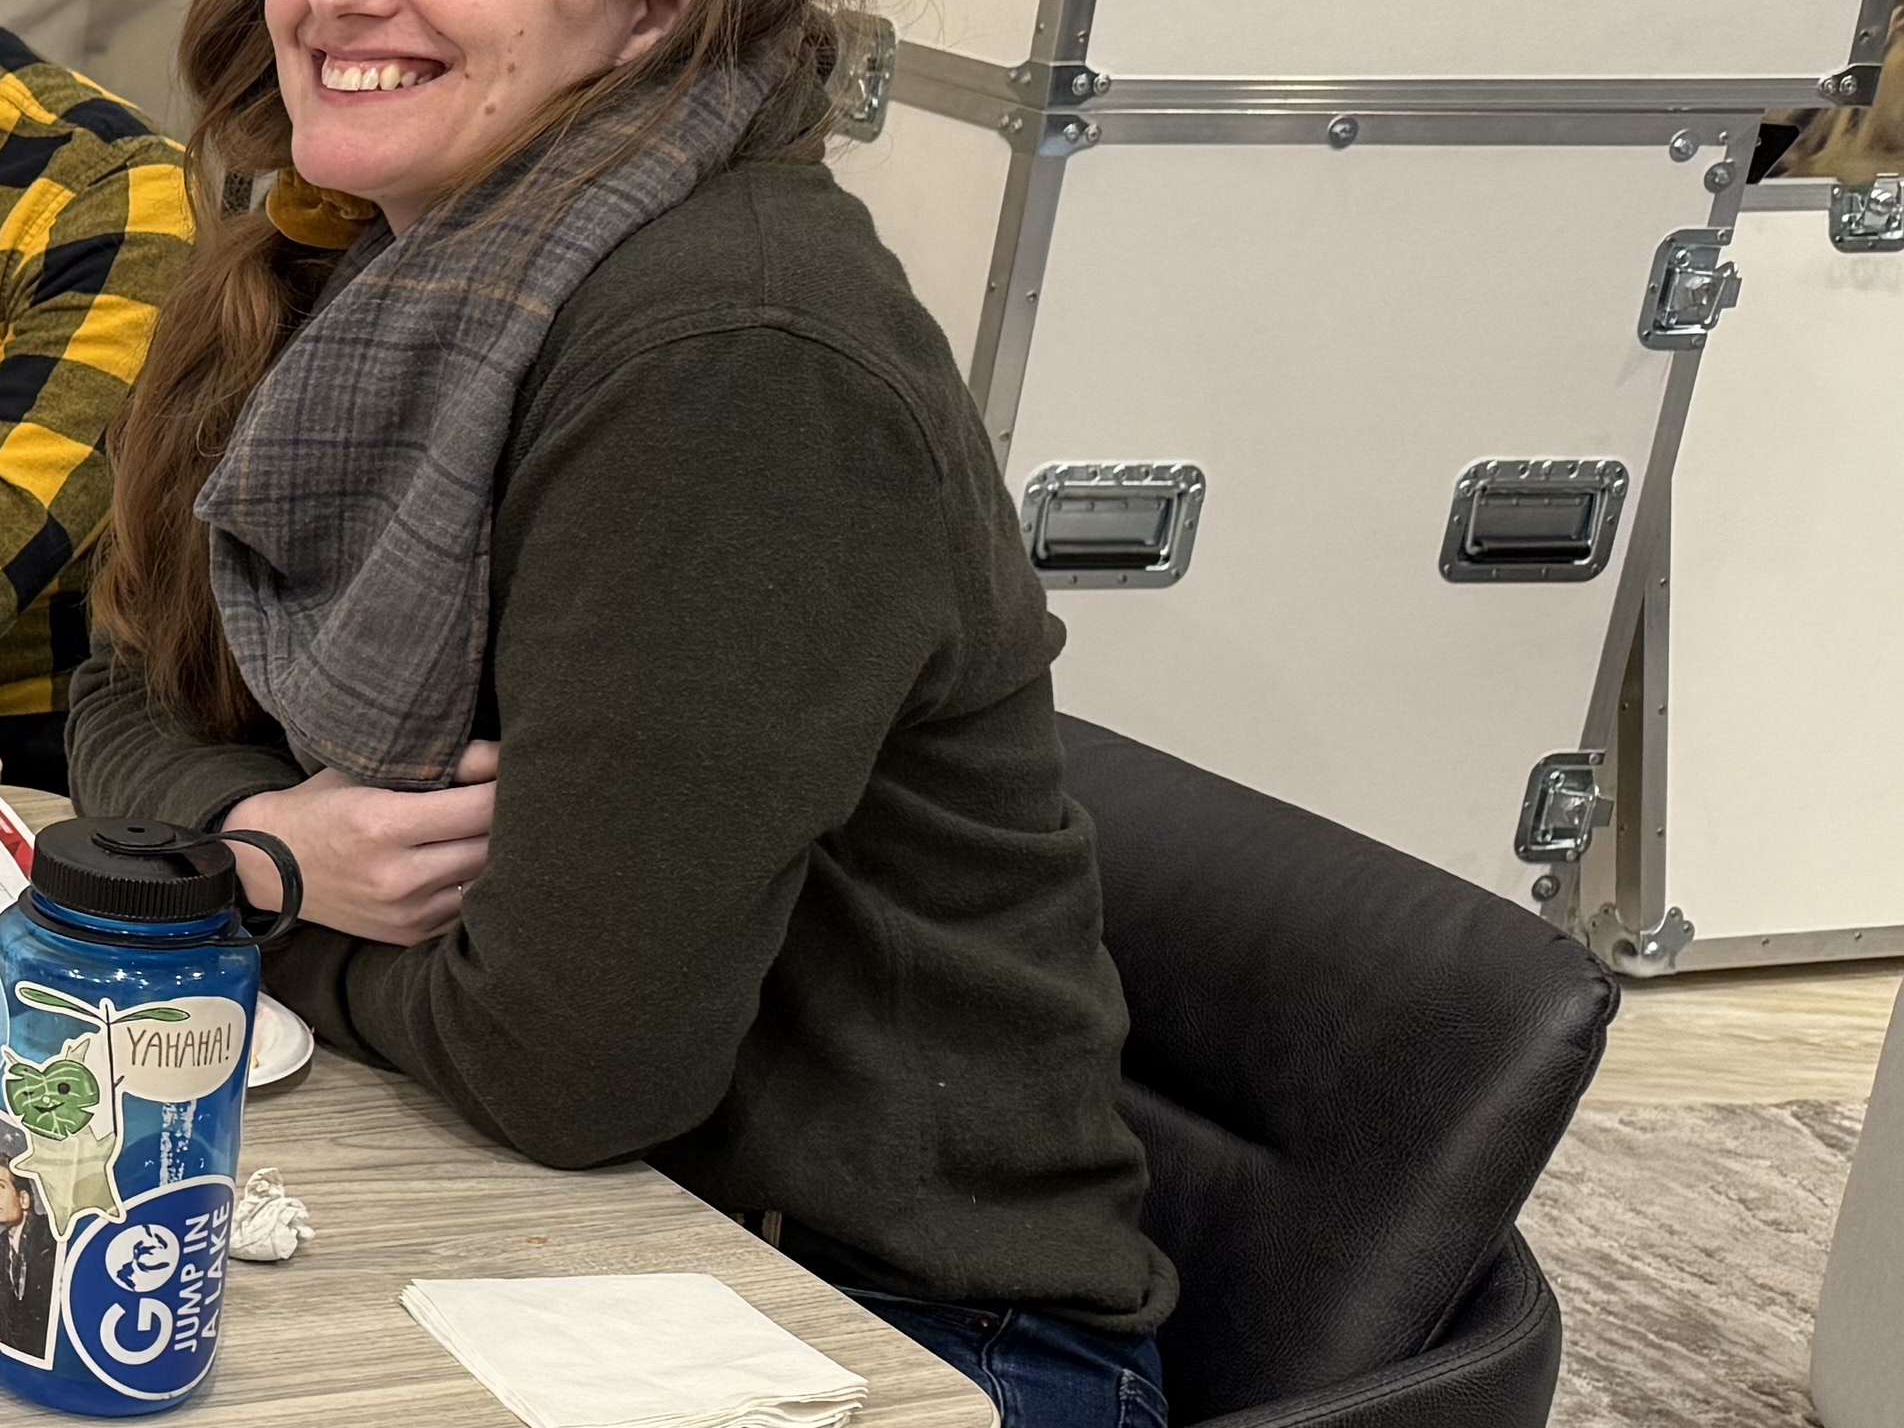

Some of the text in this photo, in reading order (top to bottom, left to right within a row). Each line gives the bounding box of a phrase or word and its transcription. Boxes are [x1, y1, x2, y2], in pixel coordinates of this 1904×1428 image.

[126, 1022, 232, 1068] YAHAHA!
[173, 1213, 211, 1353] JUMP IN
[200, 1200, 231, 1338] A LAKE
